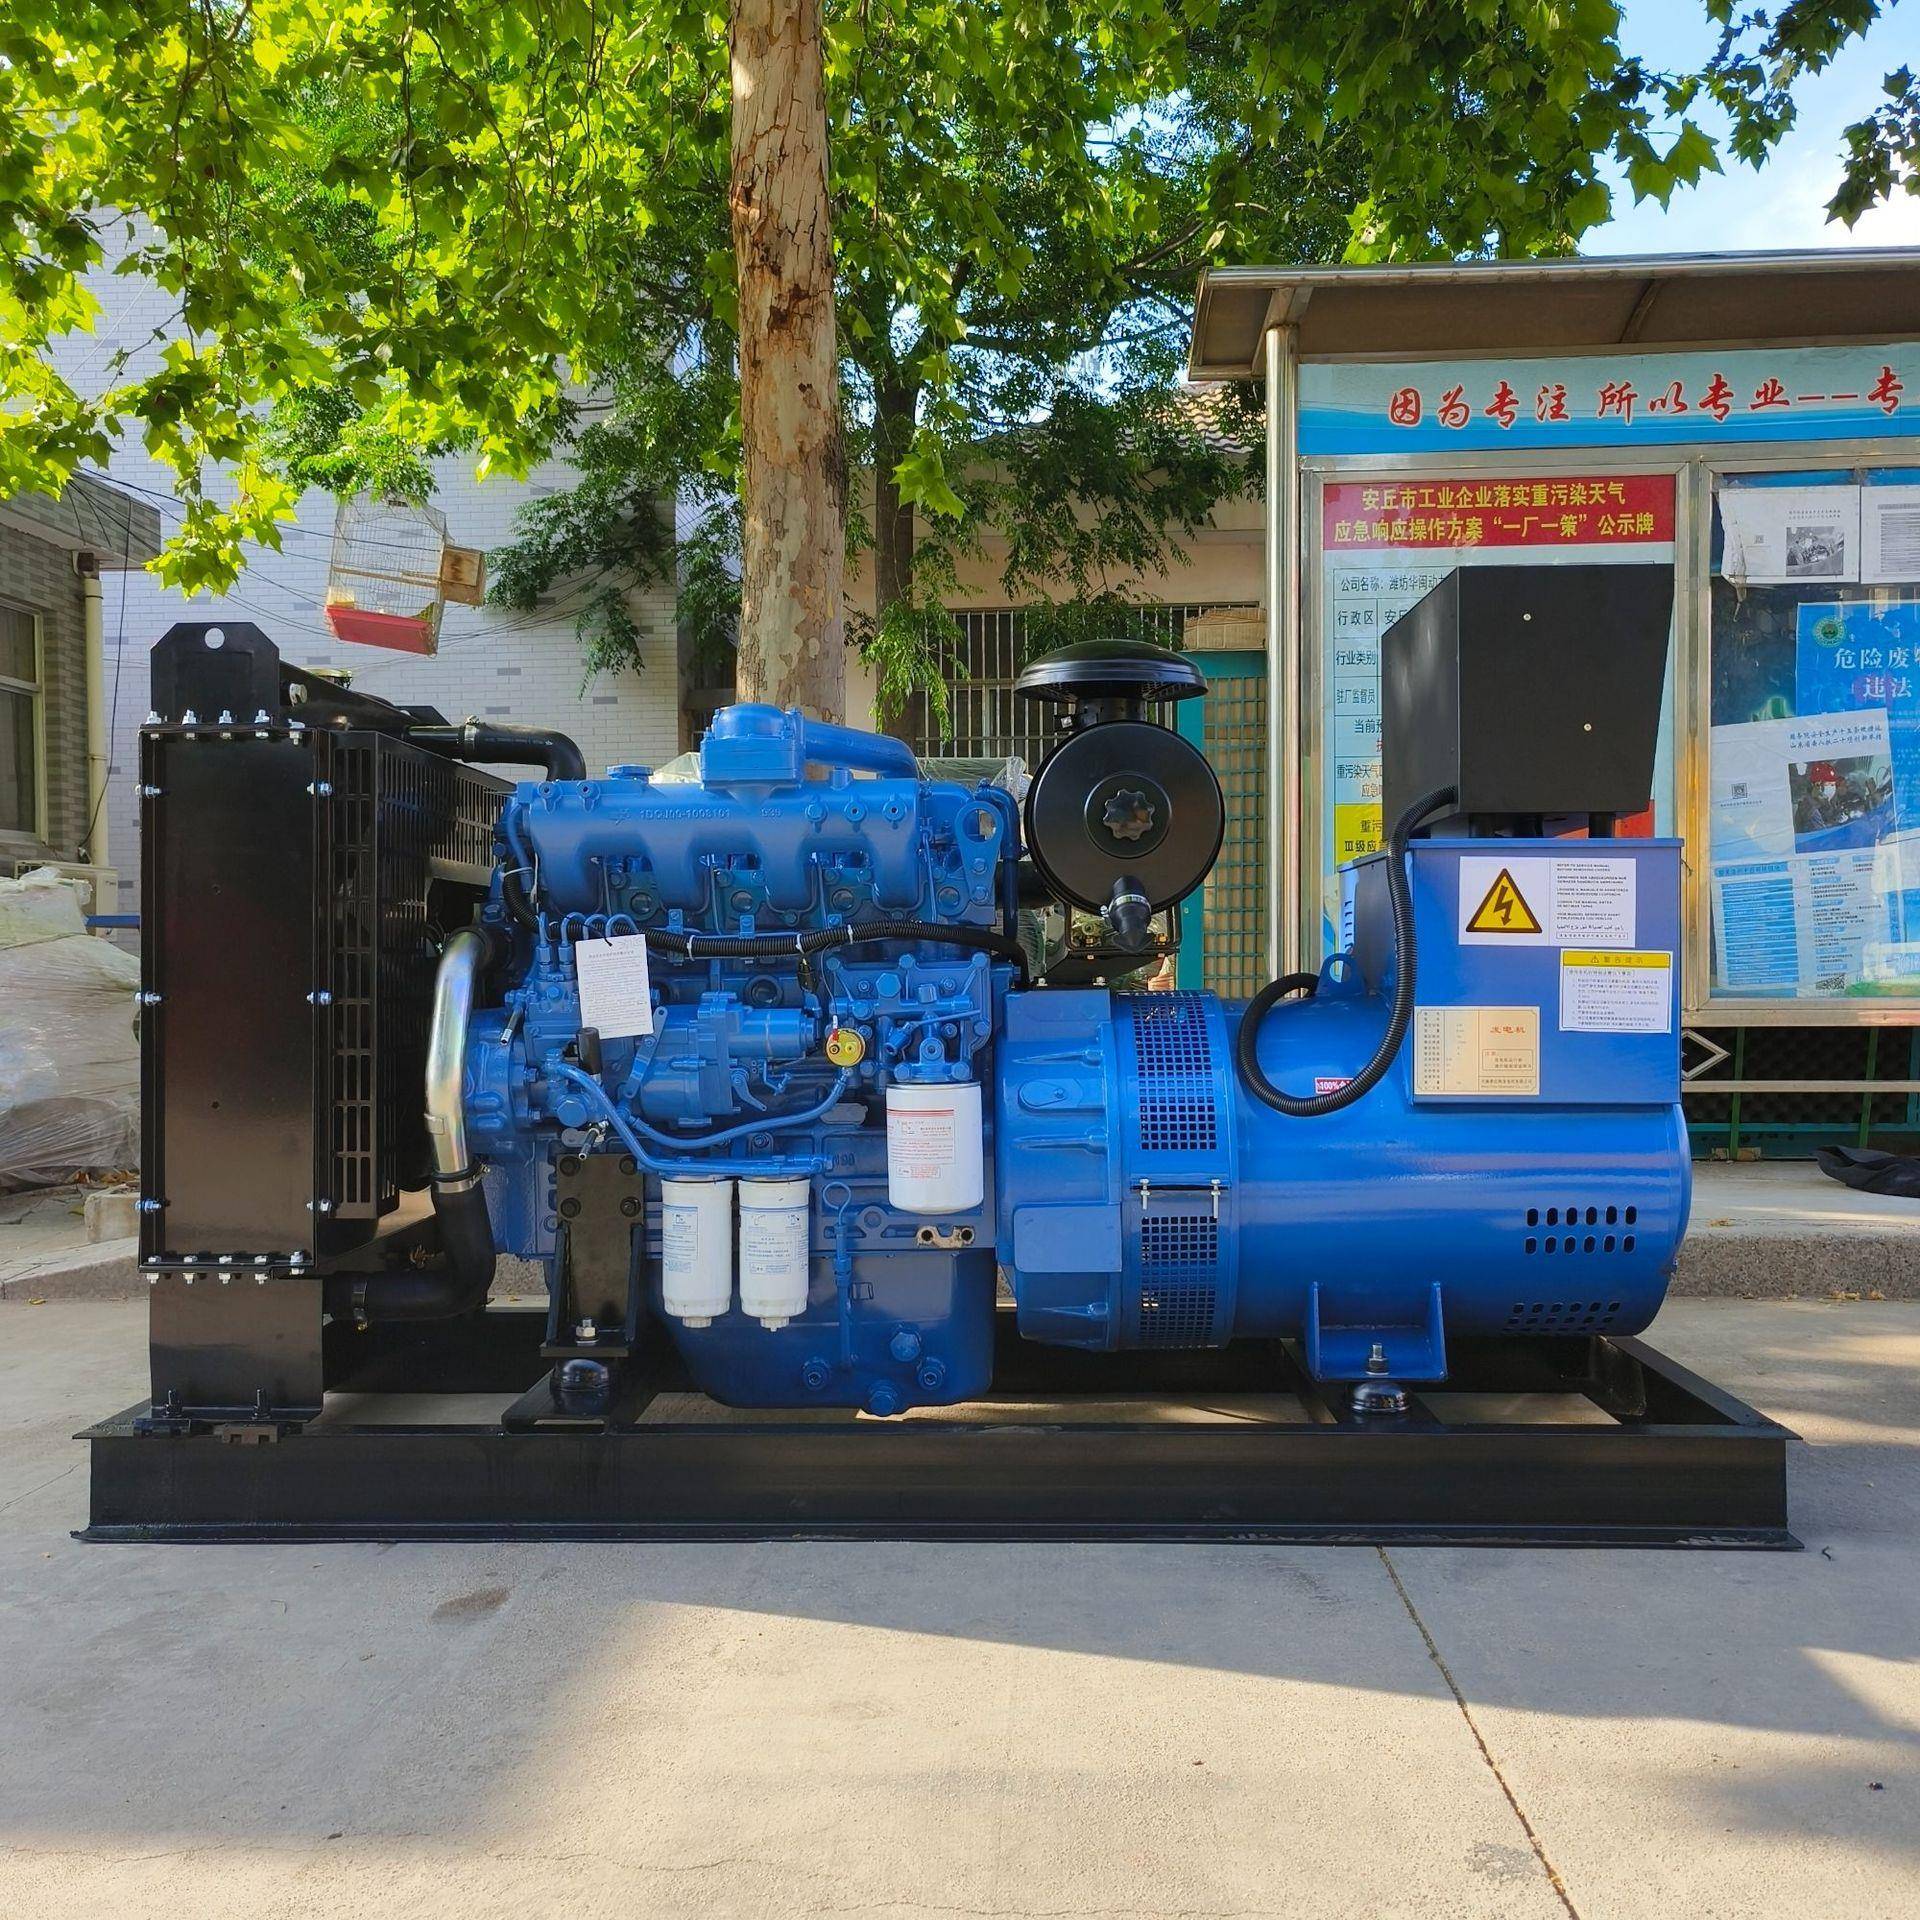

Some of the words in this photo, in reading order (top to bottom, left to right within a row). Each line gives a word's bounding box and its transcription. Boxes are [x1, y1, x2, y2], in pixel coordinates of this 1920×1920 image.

[1390, 381, 1570, 428] 因为专注
[1362, 481, 1627, 511] 安丘市工业企业落实重污染天气
[1337, 609, 1374, 626] 行政区
[1335, 650, 1376, 666] 行业类别
[1336, 688, 1376, 704] 驻厂监督员
[1862, 676, 1913, 699] 违法
[1490, 1025, 1526, 1034] 发电机
